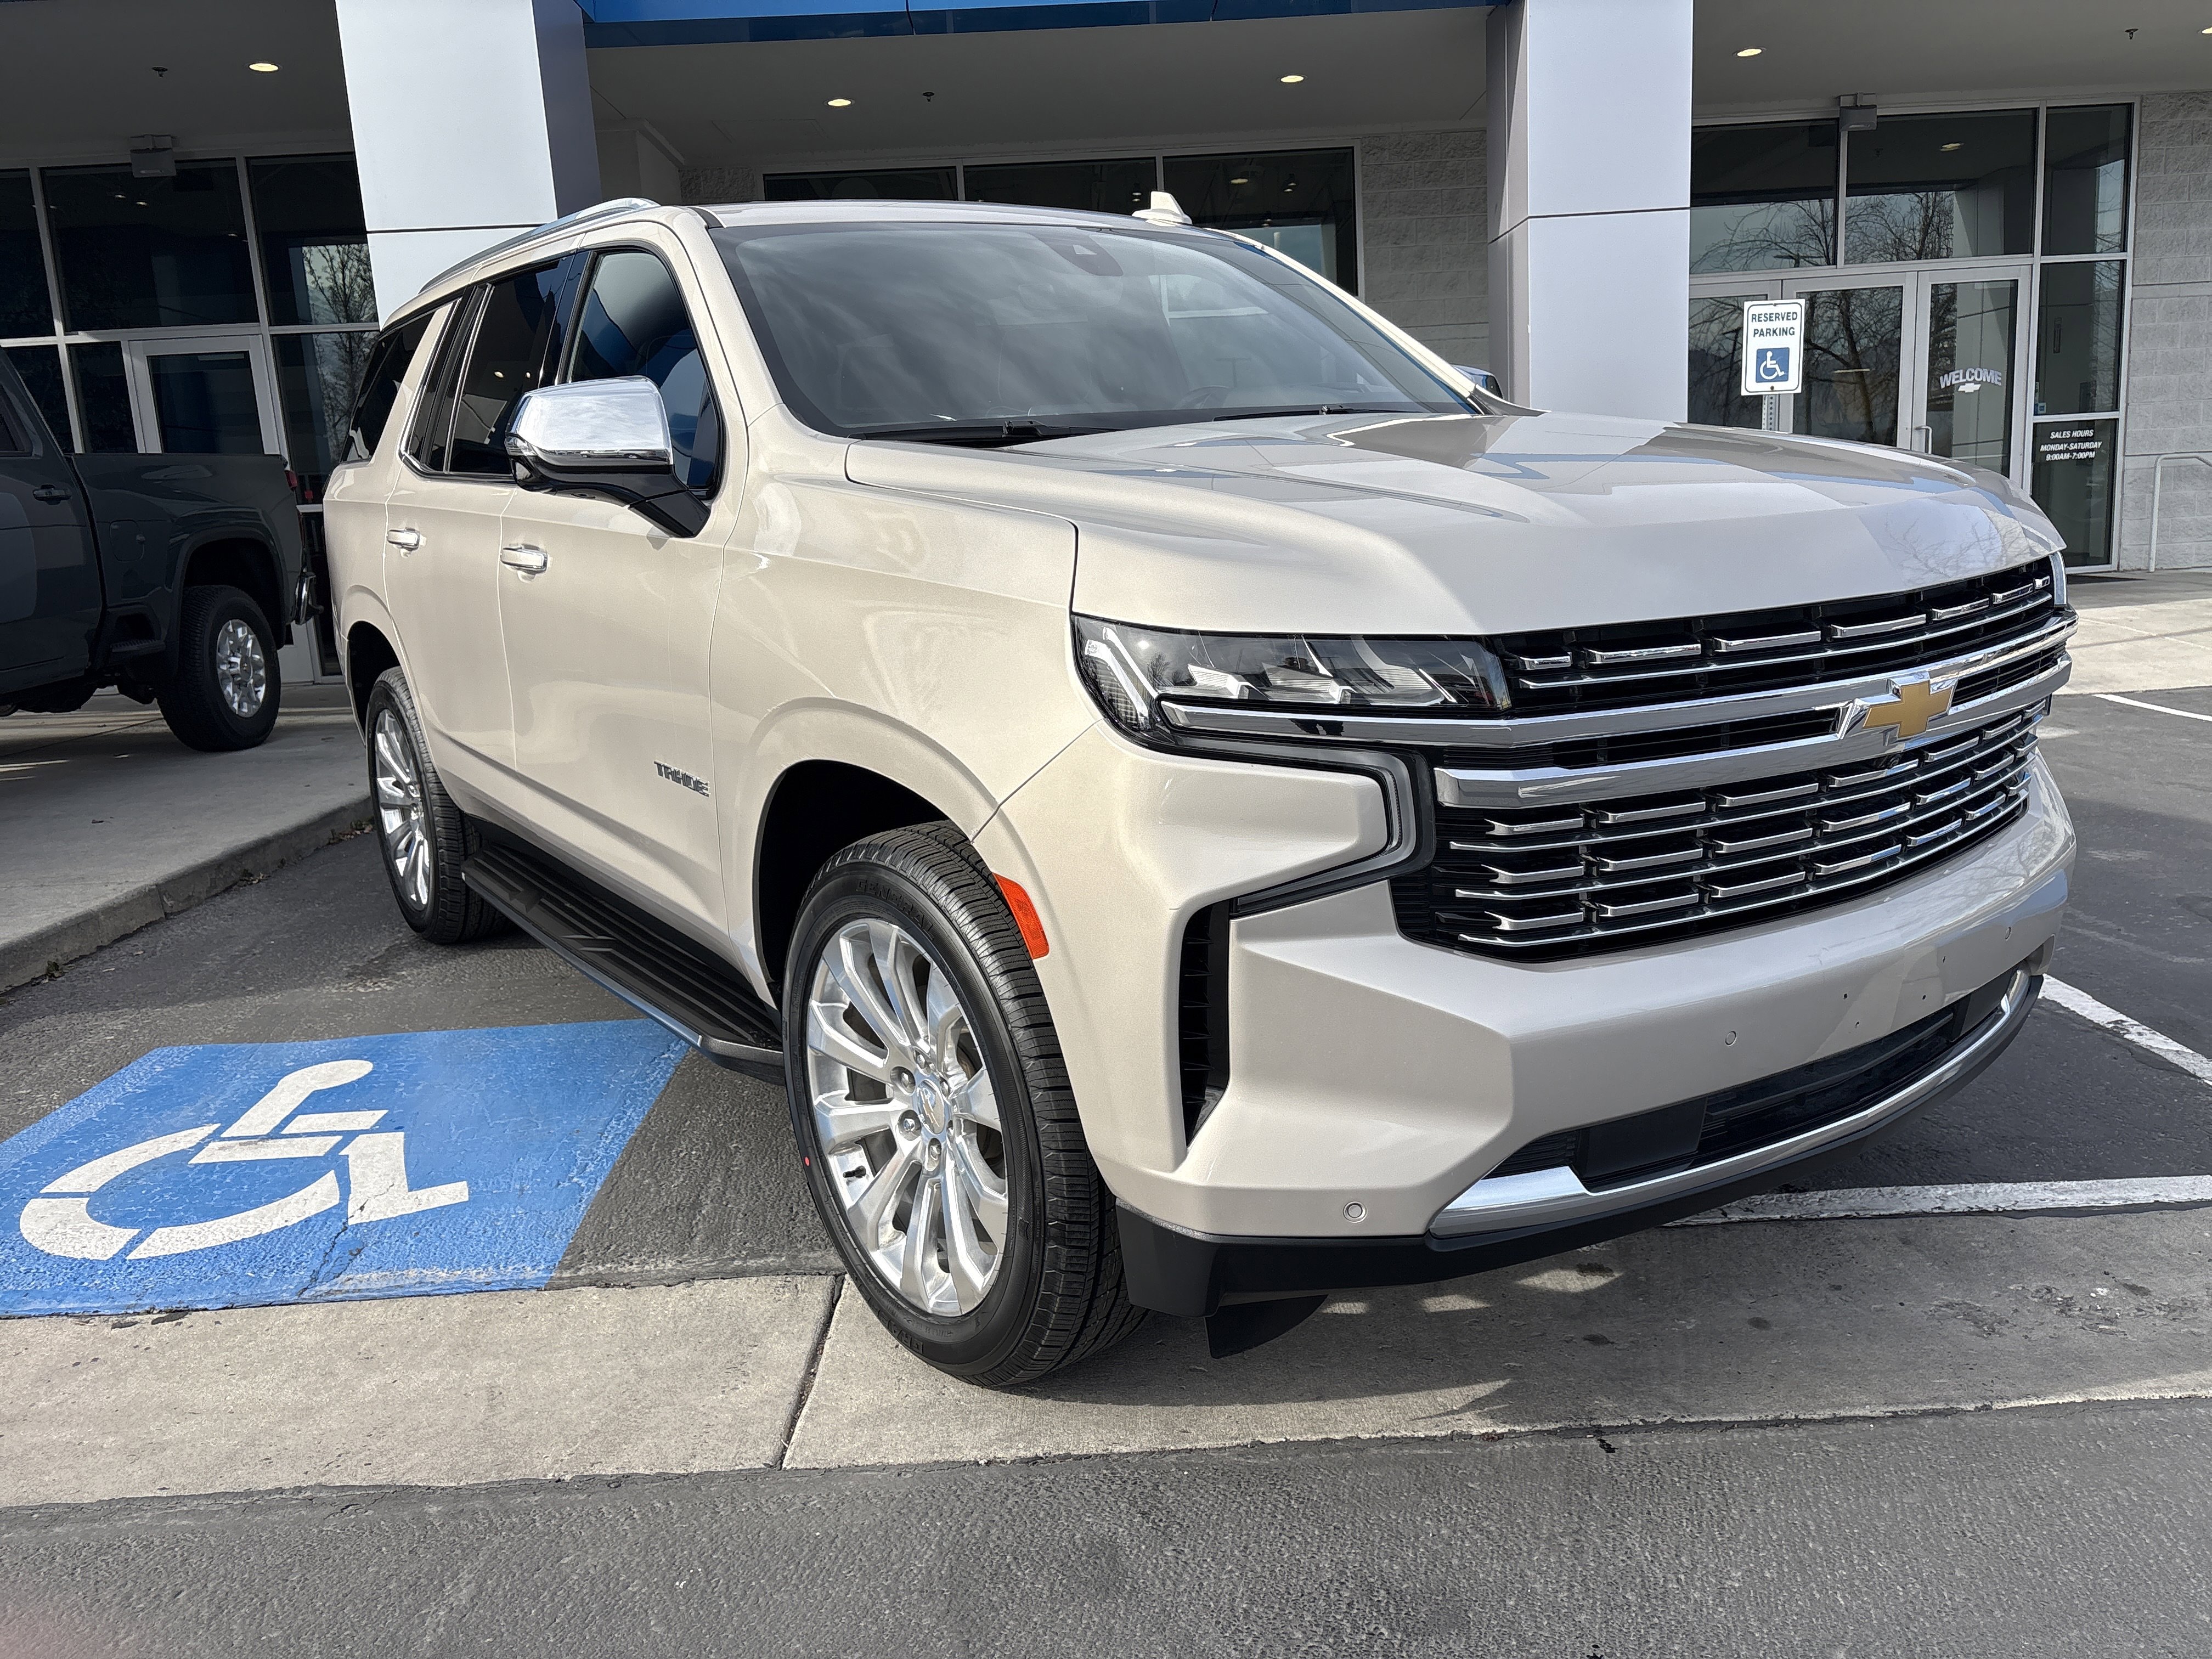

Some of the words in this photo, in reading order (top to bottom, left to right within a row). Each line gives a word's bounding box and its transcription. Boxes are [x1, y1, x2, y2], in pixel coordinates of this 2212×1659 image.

[1751, 312, 1798, 323] RESERVED
[1753, 326, 1795, 337] PARKING
[1939, 368, 2002, 389] WELCOME
[2050, 431, 2070, 439] SALES
[2072, 430, 2094, 438] HOURS
[2040, 442, 2103, 452] MONDAY-SATURDAY
[654, 760, 711, 797] TAHOE
[855, 879, 935, 941] GENERAL
